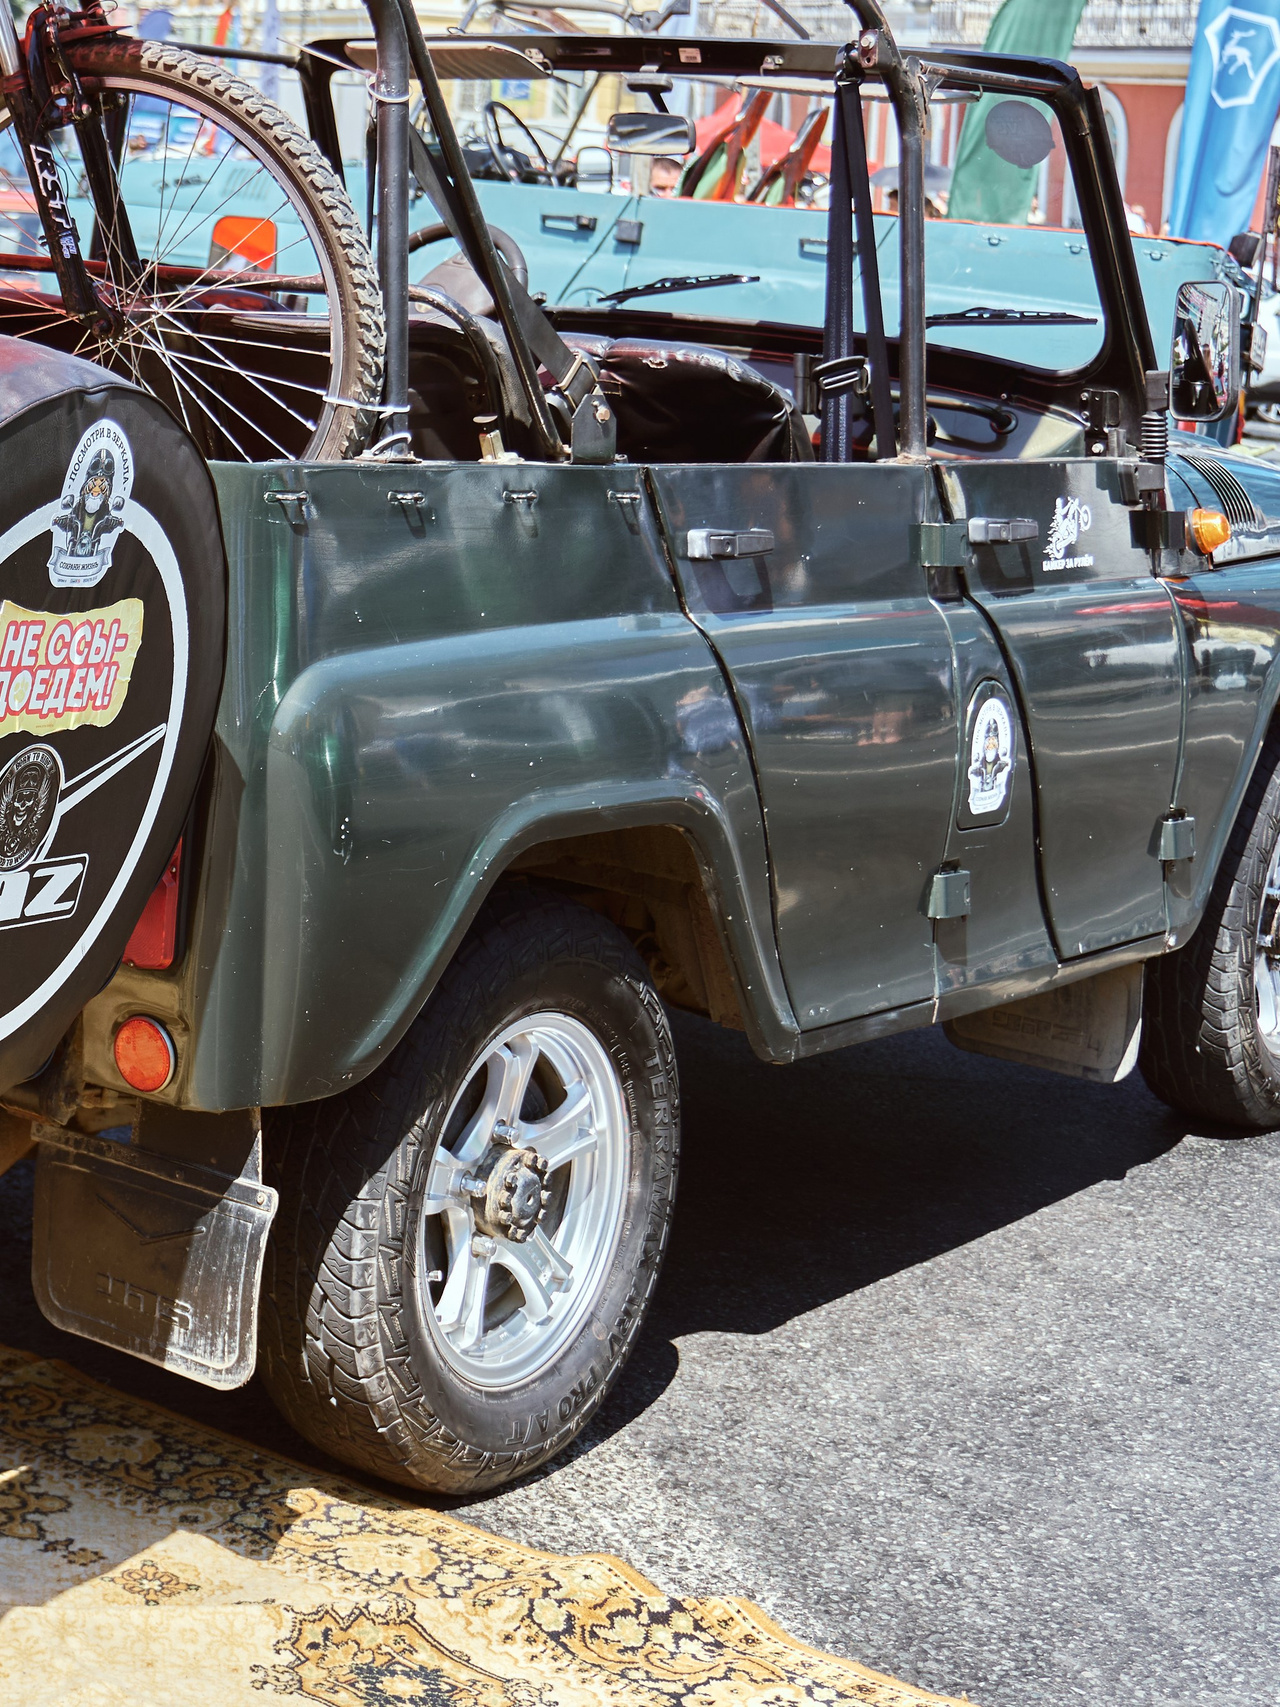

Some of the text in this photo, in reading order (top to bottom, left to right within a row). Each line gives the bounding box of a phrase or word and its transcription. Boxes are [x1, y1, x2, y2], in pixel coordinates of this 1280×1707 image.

[30, 144, 72, 229] RST
[70, 427, 130, 485] ПОСМОТРИ В ЗЕРКАЛА
[81, 561, 99, 570] ЖИЗНЬ
[1066, 558, 1074, 569] ЗА
[0, 619, 128, 669] НЕ ССЫ-
[637, 1052, 670, 1270] TERRAMAX
[556, 1363, 600, 1421] PRO
[505, 1408, 551, 1445] A/T
